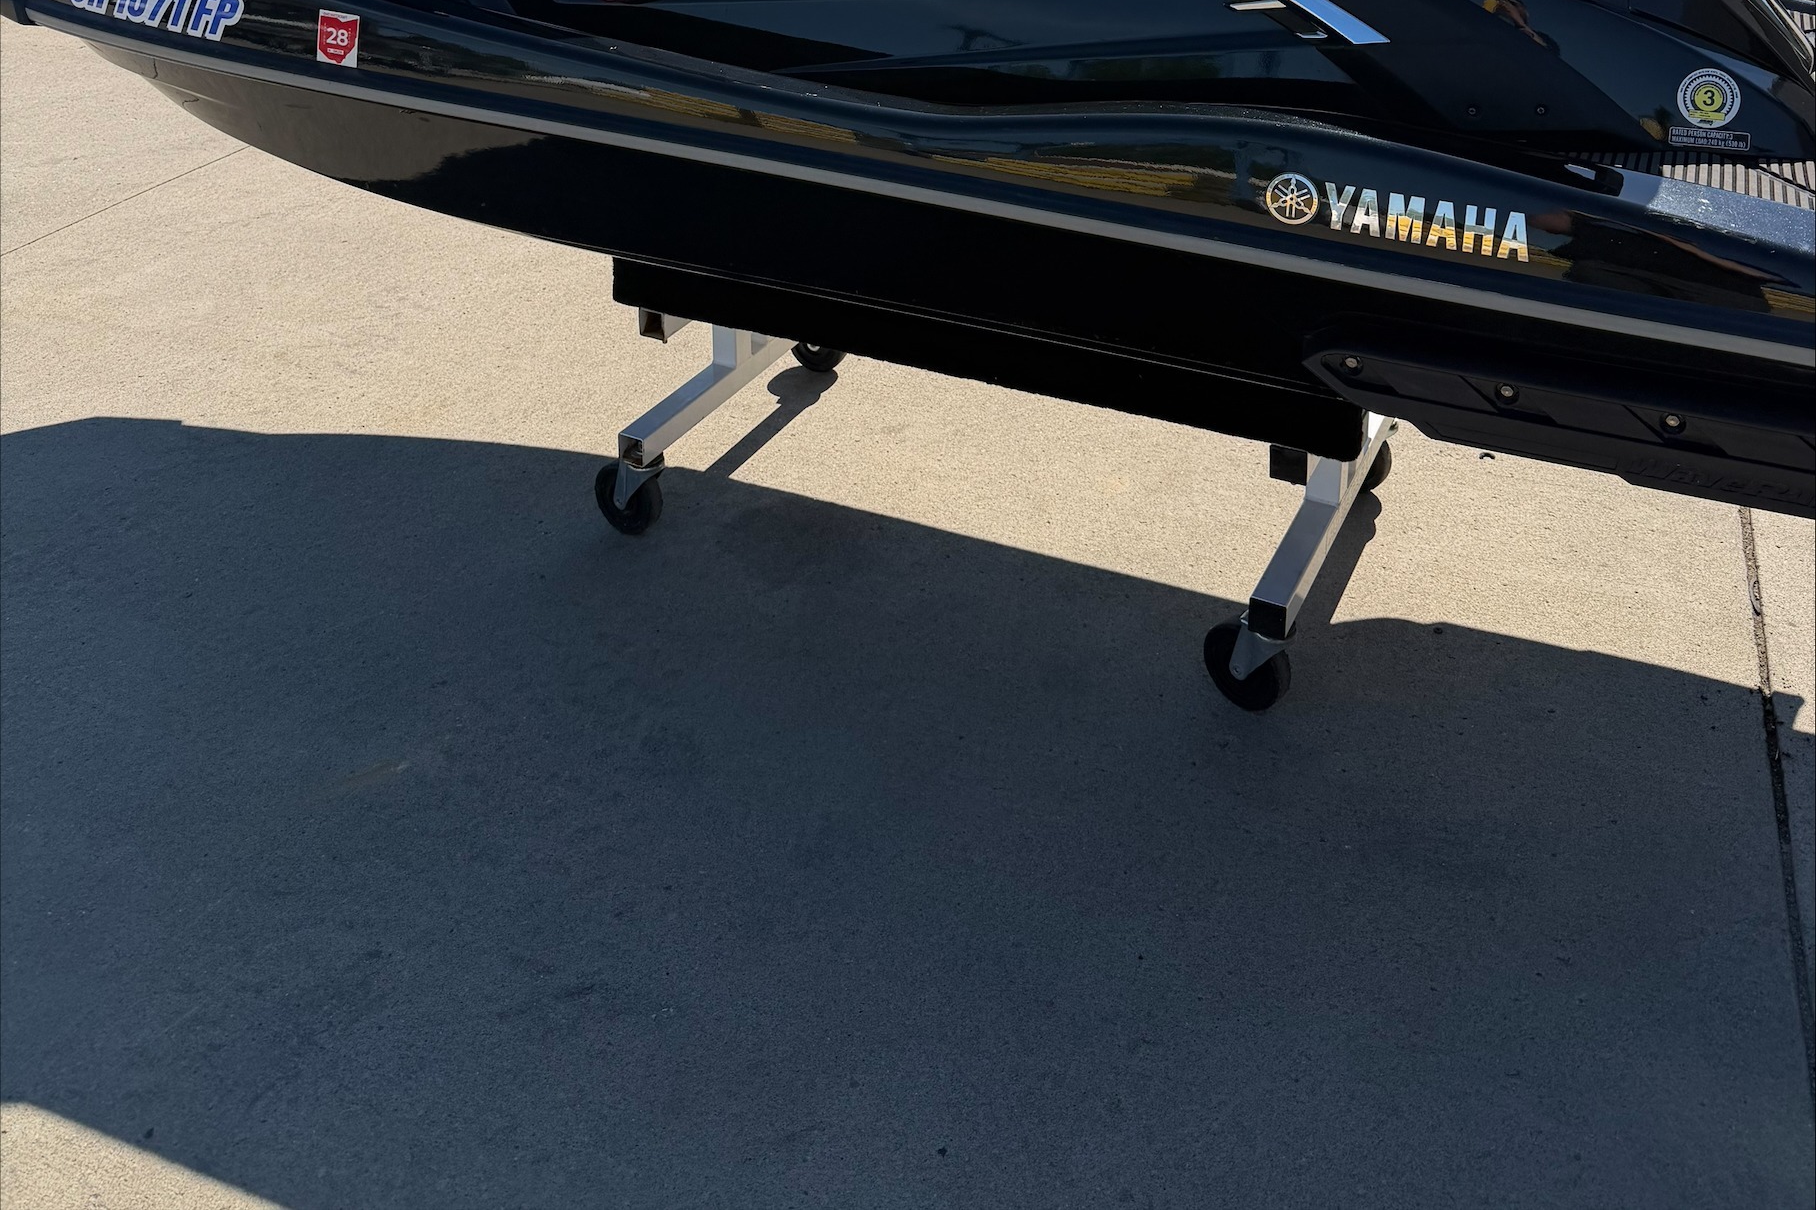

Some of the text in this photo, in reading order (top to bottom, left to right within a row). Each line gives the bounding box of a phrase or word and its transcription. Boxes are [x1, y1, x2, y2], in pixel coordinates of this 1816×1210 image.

[326, 27, 349, 47] 28
[1702, 89, 1715, 107] 3
[1671, 135, 1695, 144] MAXIMUM
[1672, 128, 1687, 136] RATED
[1688, 129, 1707, 138] PERSON
[1325, 181, 1529, 263] YAMAHA
